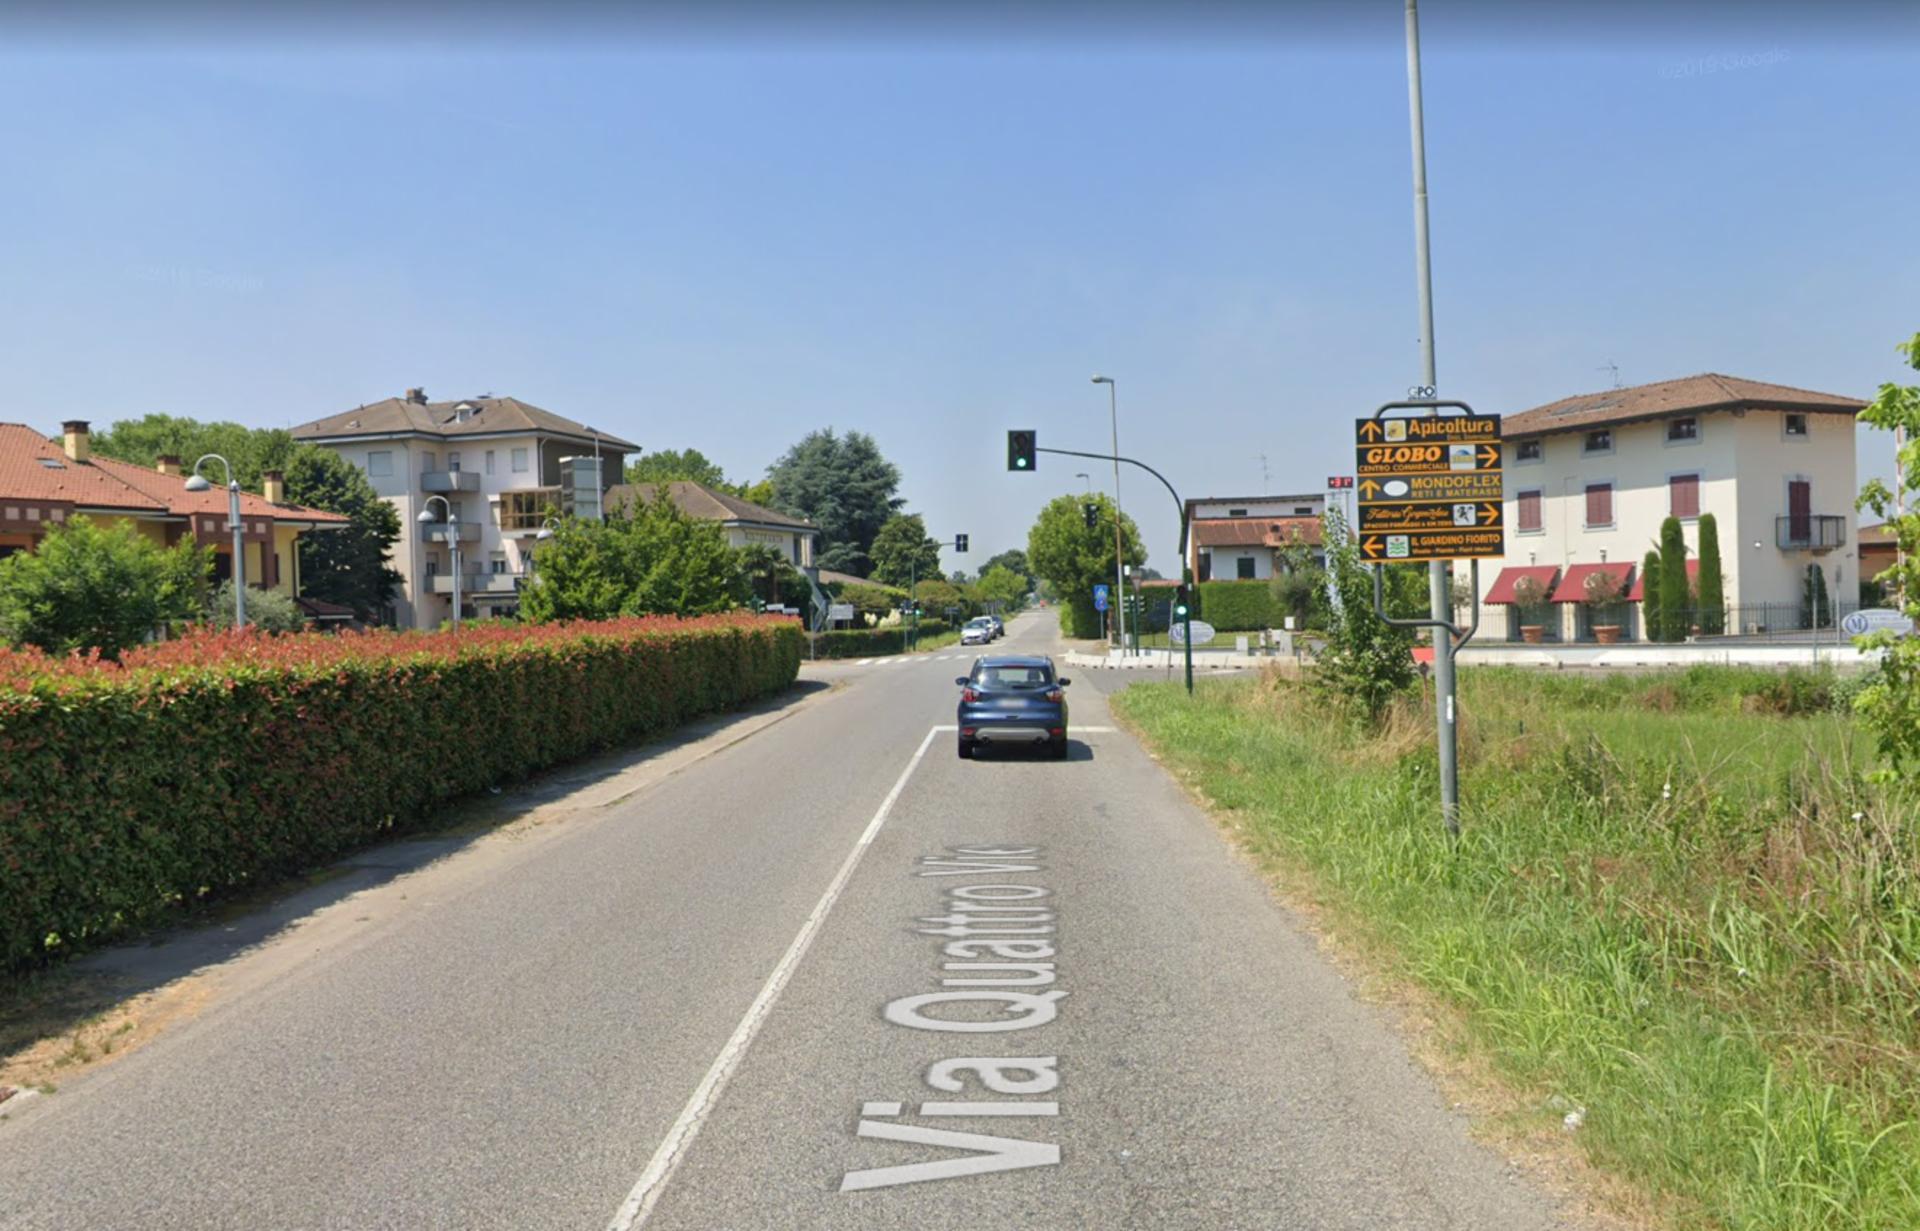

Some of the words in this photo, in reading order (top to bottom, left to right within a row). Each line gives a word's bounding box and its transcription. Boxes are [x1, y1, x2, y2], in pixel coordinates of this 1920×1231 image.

[1408, 417, 1494, 438] Apicoltura
[1366, 446, 1442, 464] GLOBO
[1358, 464, 1391, 472] CENTRO
[1392, 462, 1449, 471] COMMERCIALE
[1411, 475, 1501, 489] MONDOFLEX
[1411, 490, 1434, 498] RETI
[1436, 489, 1443, 497] E
[1446, 487, 1502, 497] MATERASSI
[1420, 535, 1464, 546] GIARDINO
[1465, 533, 1501, 545] FIORITO
